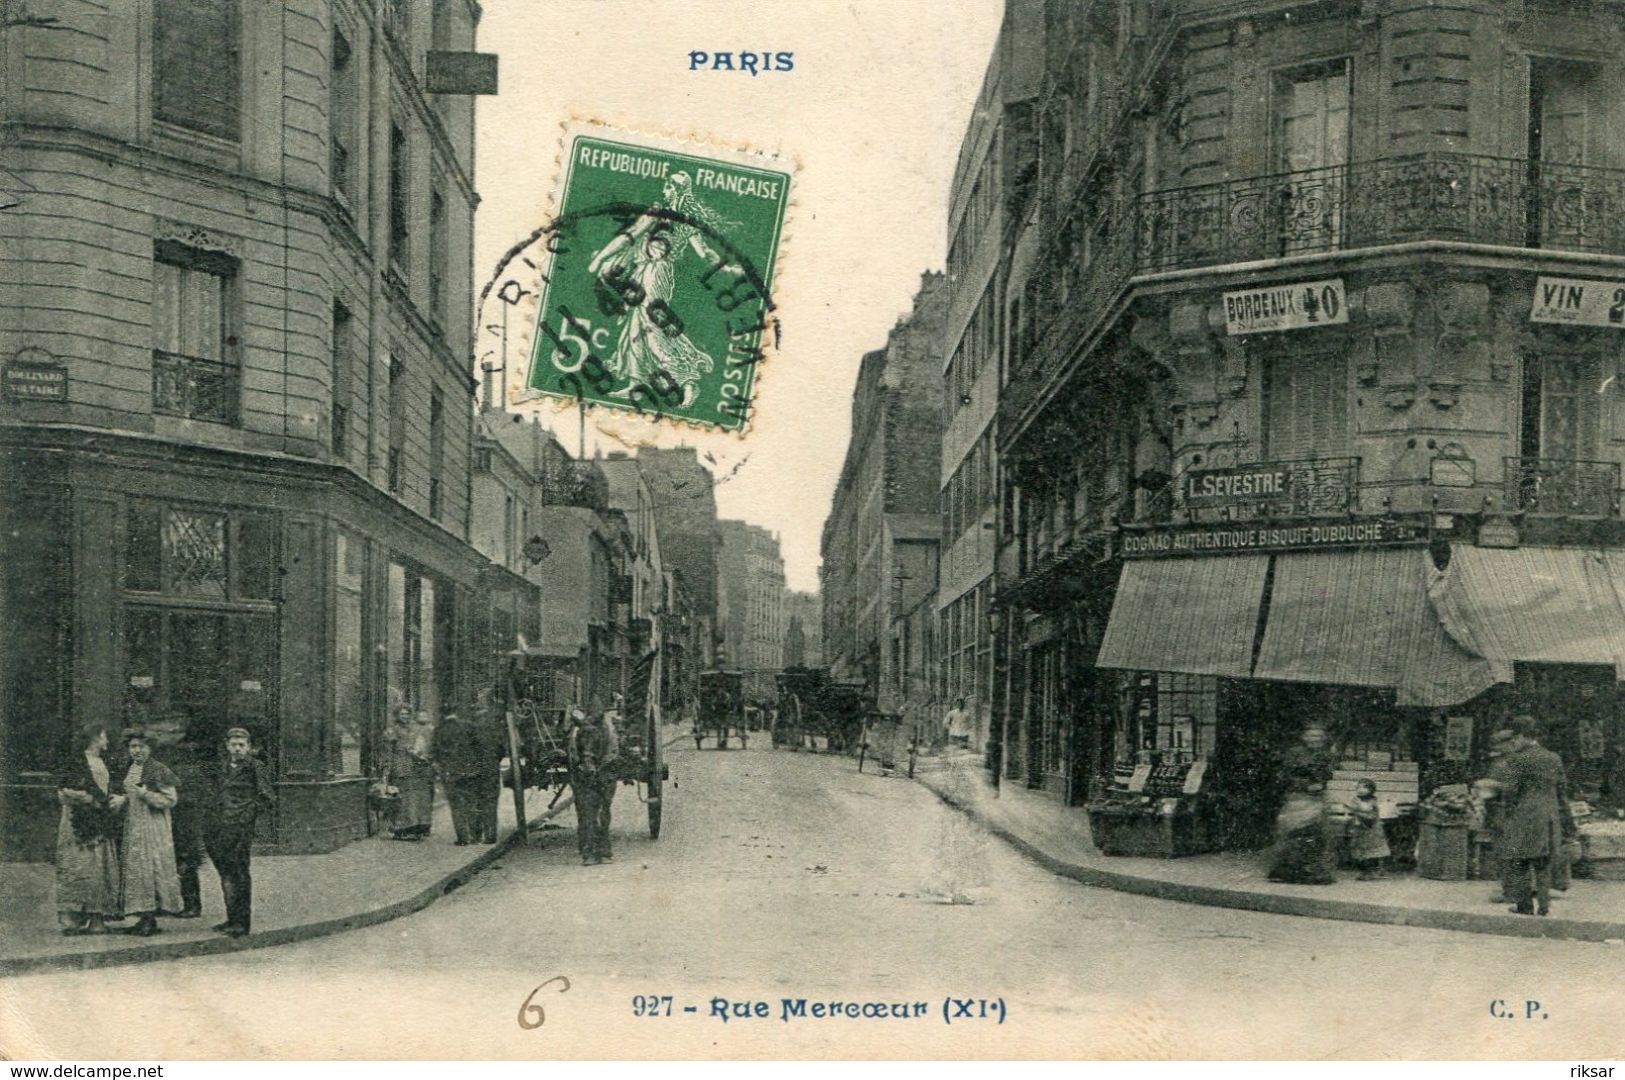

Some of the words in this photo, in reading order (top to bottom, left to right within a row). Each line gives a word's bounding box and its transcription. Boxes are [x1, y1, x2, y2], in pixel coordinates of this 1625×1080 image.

[695, 167, 779, 201] FRANÇAISE
[1226, 289, 1297, 322] BORDEAUX
[1303, 284, 1340, 323] 40
[1543, 283, 1585, 310] VIN
[1124, 534, 1171, 552] COGNAC
[1173, 529, 1256, 550] AUTHENTIQUE
[517, 975, 571, 1030] 6
